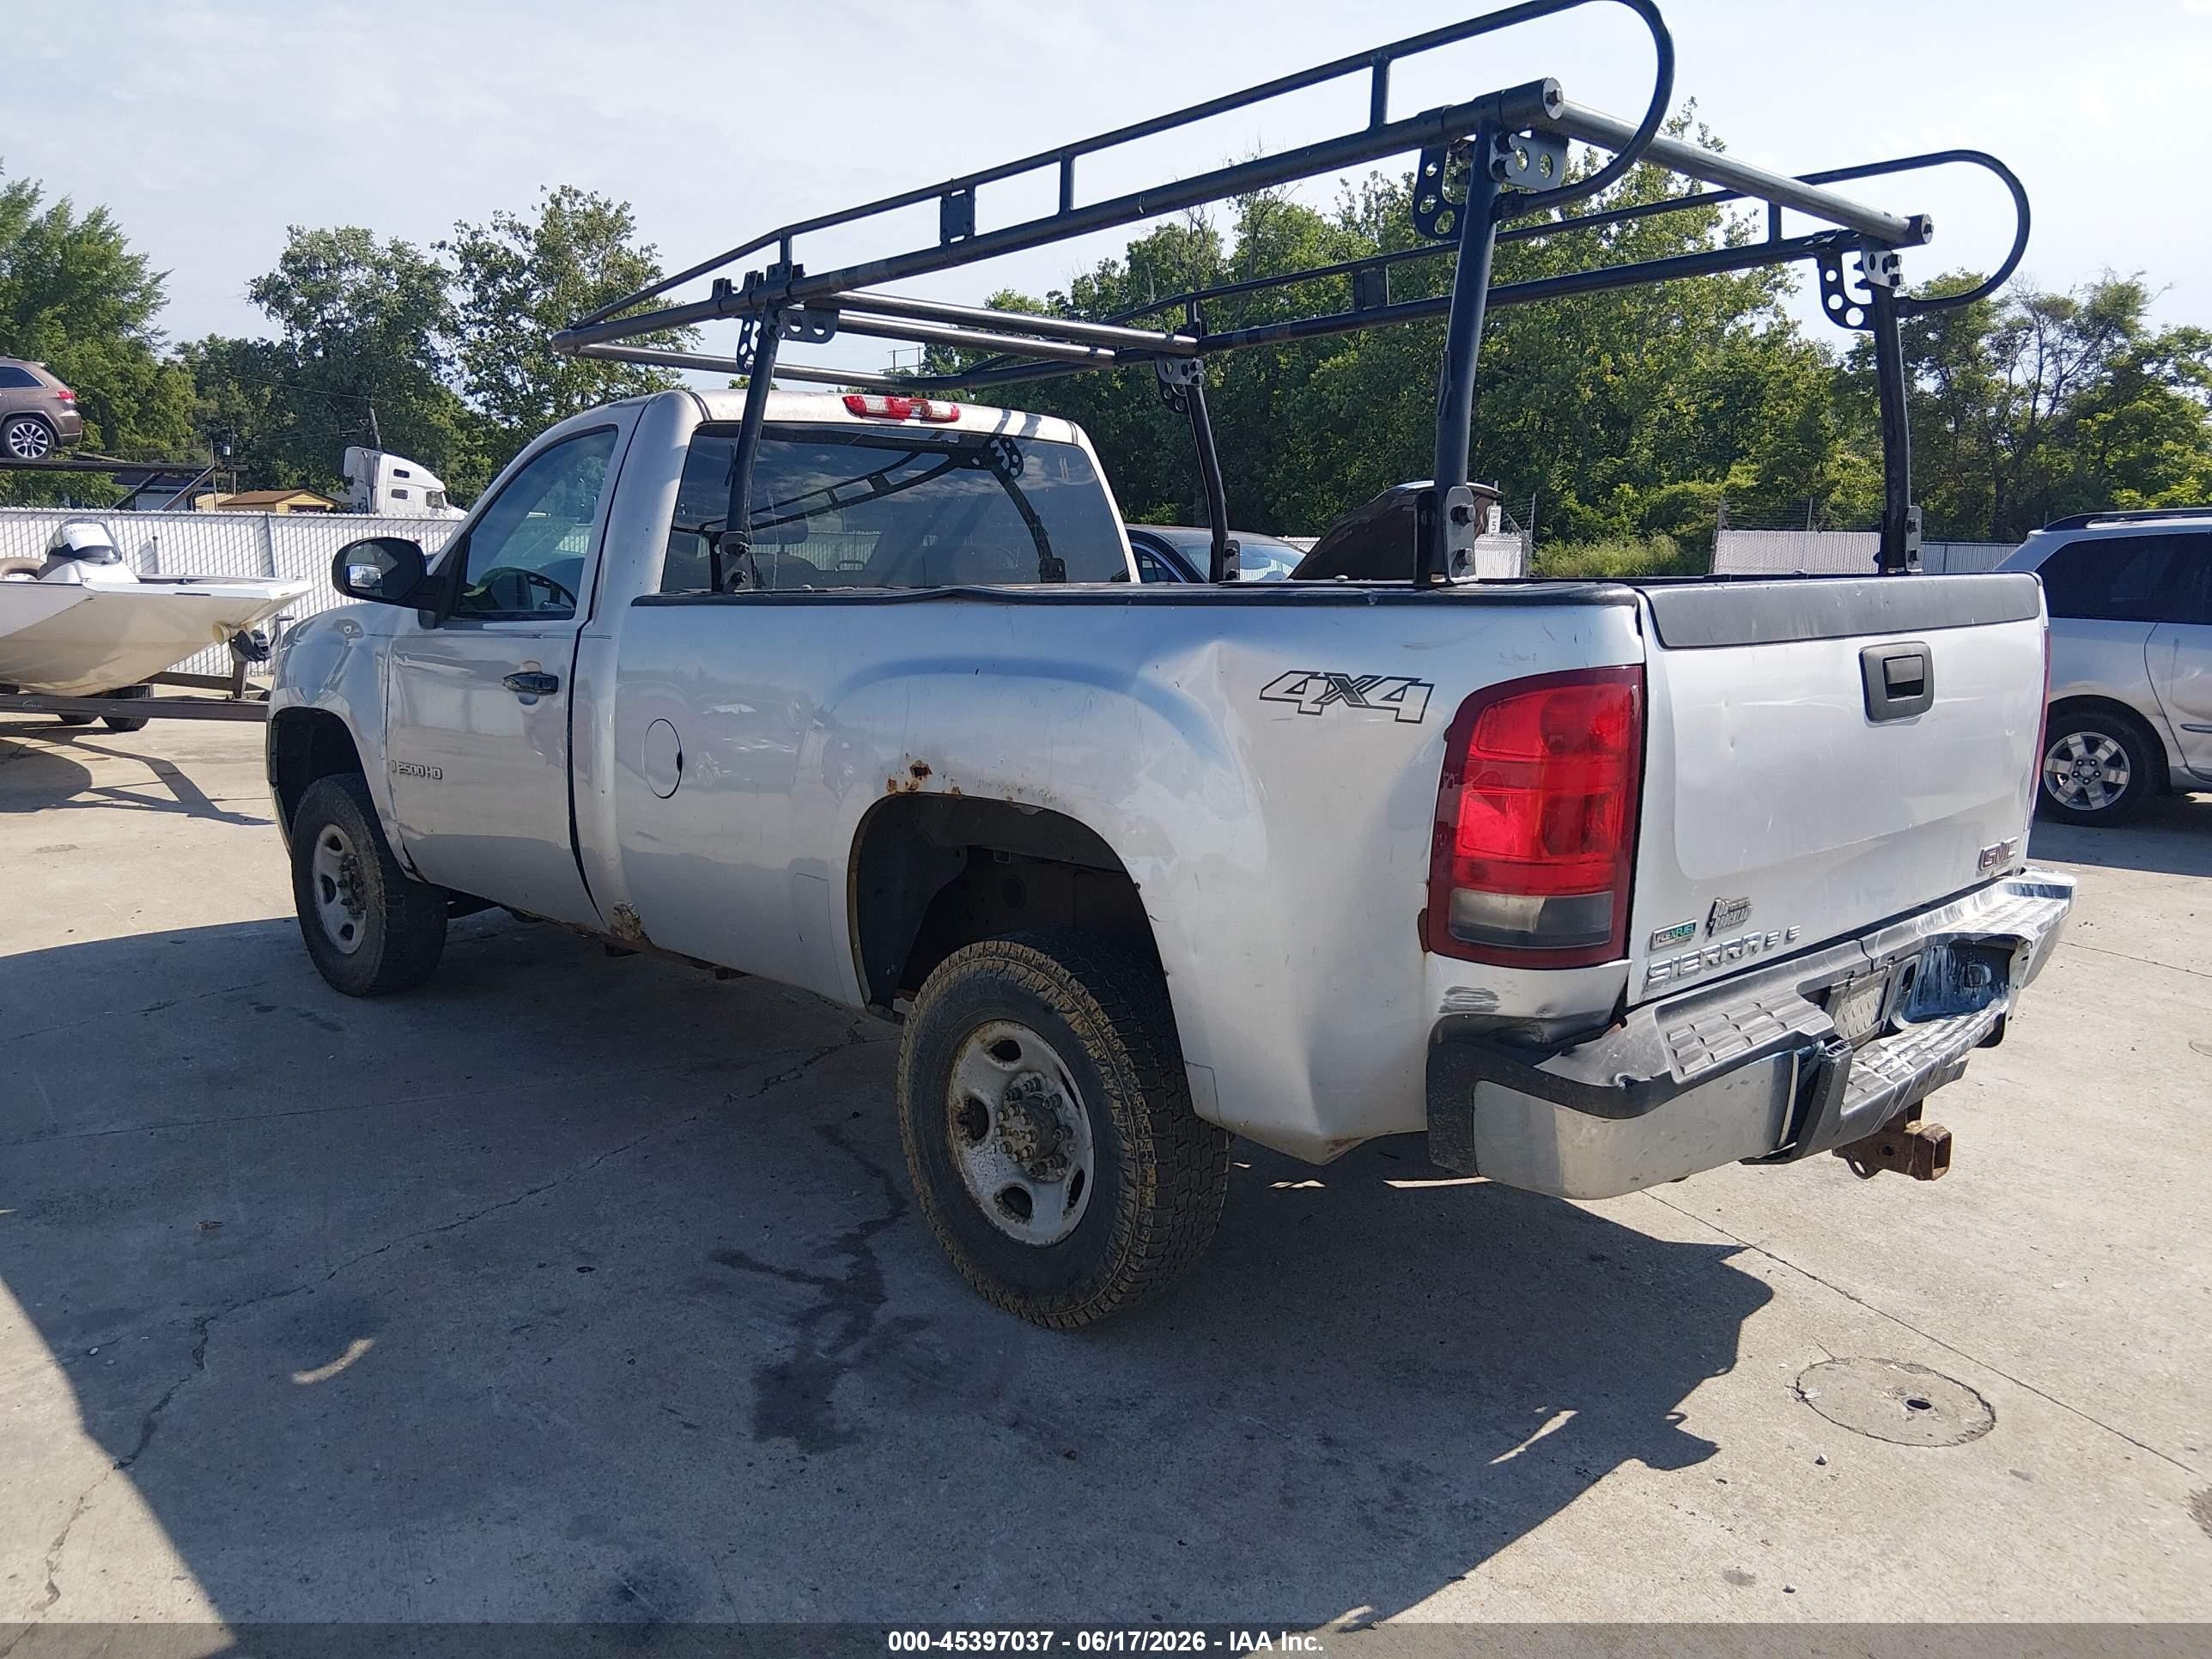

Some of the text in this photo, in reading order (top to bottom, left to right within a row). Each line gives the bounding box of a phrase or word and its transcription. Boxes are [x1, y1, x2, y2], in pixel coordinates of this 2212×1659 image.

[1492, 520, 1497, 531] 5
[1978, 836, 2018, 871] GMC
[1646, 931, 1761, 986] SIERRA
